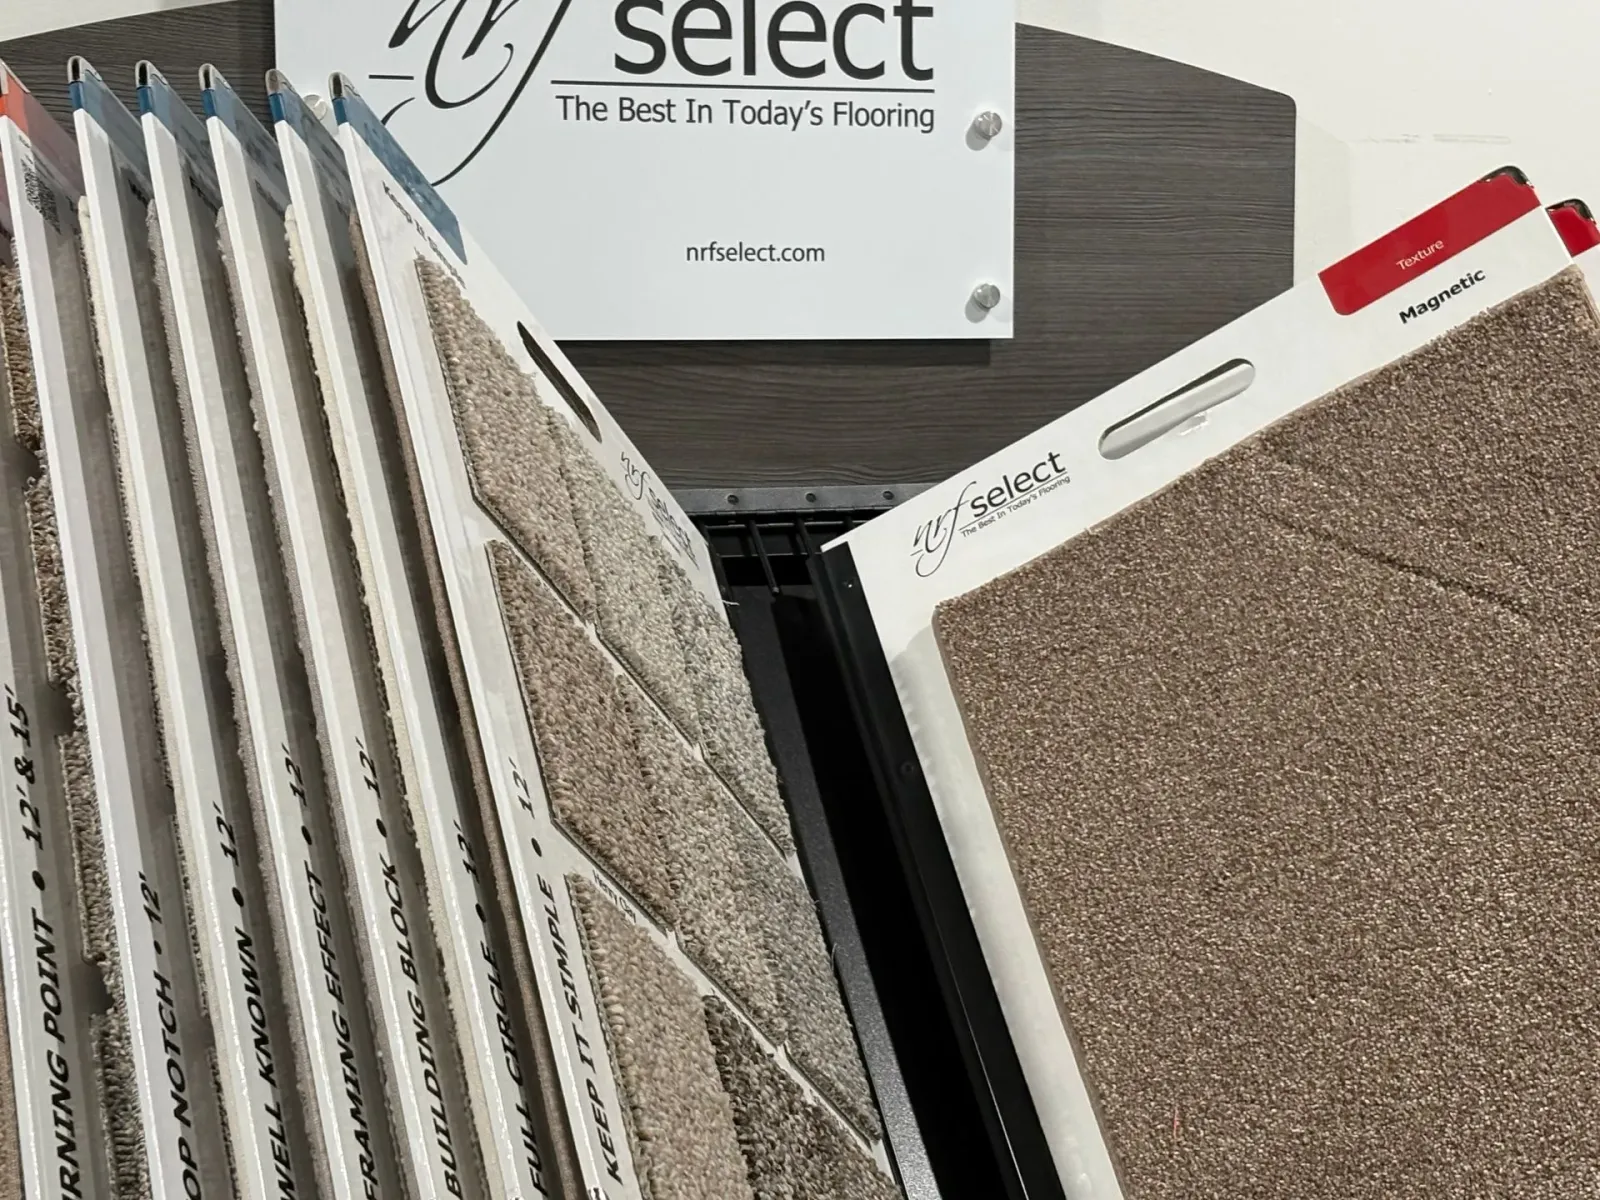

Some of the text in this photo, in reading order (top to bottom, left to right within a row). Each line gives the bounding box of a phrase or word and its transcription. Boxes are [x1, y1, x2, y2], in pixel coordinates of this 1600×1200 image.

[614, 0, 934, 81] select
[555, 95, 935, 133] The Best In Today's Flooring
[686, 241, 825, 262] nrfselect.com
[1396, 240, 1444, 269] Texture
[1399, 270, 1486, 324] Magnetic
[960, 526, 977, 538] The
[978, 515, 996, 530] Best
[996, 510, 1006, 519] In
[1038, 475, 1071, 497] Flooring
[970, 452, 1066, 518] select
[138, 871, 163, 924] 12'
[4, 684, 82, 1200] RNING POINT 12' & 15'
[281, 742, 380, 1200] FRAMING EFFECT 12'
[355, 736, 462, 1200] BUILDING BLOCK 12'
[508, 756, 624, 1186] KEEP IT SIMPLE 12'
[213, 801, 300, 1200] WELL KNOWN 12'
[453, 819, 549, 1198] FULL CIRCLE 12'
[153, 970, 191, 1128] NOTCH
